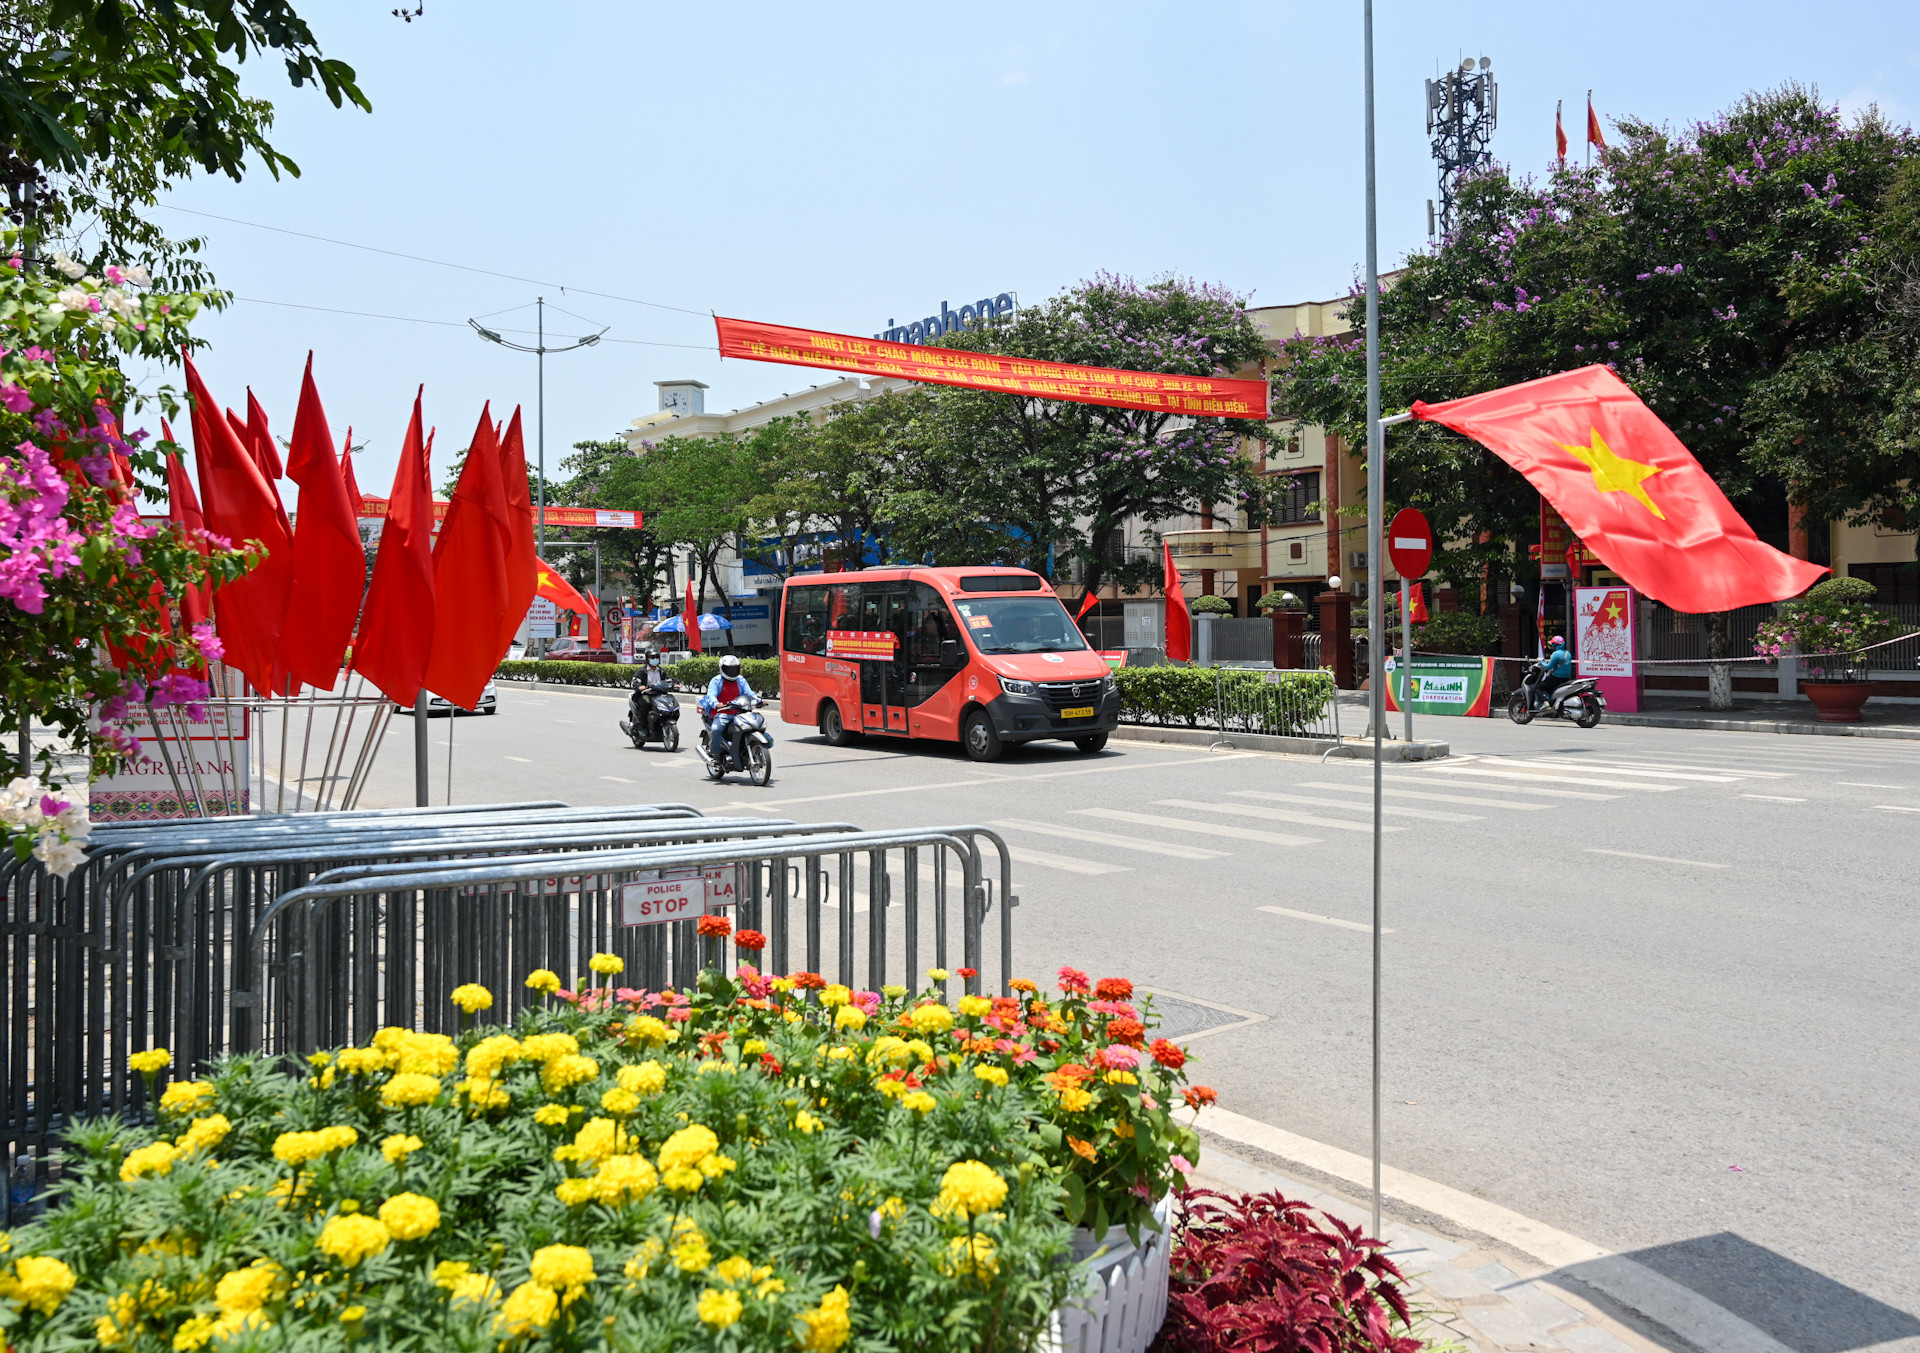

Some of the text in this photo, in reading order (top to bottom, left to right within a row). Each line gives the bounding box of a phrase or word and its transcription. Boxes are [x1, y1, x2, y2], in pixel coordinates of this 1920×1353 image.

[802, 351, 831, 365] BIÊN
[835, 355, 859, 368] PHỦ
[917, 367, 939, 378] CÚP
[944, 370, 967, 382] BÁO
[972, 374, 1002, 386] QUÂN
[1003, 377, 1022, 390] ĐỘI
[1028, 381, 1058, 393] NHÂN
[1089, 385, 1109, 398] CÁC
[1143, 392, 1161, 405] ĐUA
[1167, 395, 1180, 409] TẠI
[1203, 398, 1223, 413] ĐIỆN
[810, 336, 843, 352] NHIỆT
[847, 341, 871, 356] LIỆT
[877, 346, 907, 361] CHÀO
[911, 350, 944, 366] MỪNG
[946, 355, 969, 369] CÁC
[971, 358, 1001, 372] ĐOÀN
[1010, 362, 1033, 376] VẬN
[1034, 365, 1063, 379] ĐỘNG
[1064, 368, 1088, 381] VIÊN
[1088, 372, 1116, 384] THAM
[1119, 375, 1132, 387] DỰ
[1135, 376, 1158, 389] CUỘC
[1182, 381, 1194, 392] XE
[640, 897, 689, 916] STOP
[647, 883, 682, 895] POLICE
